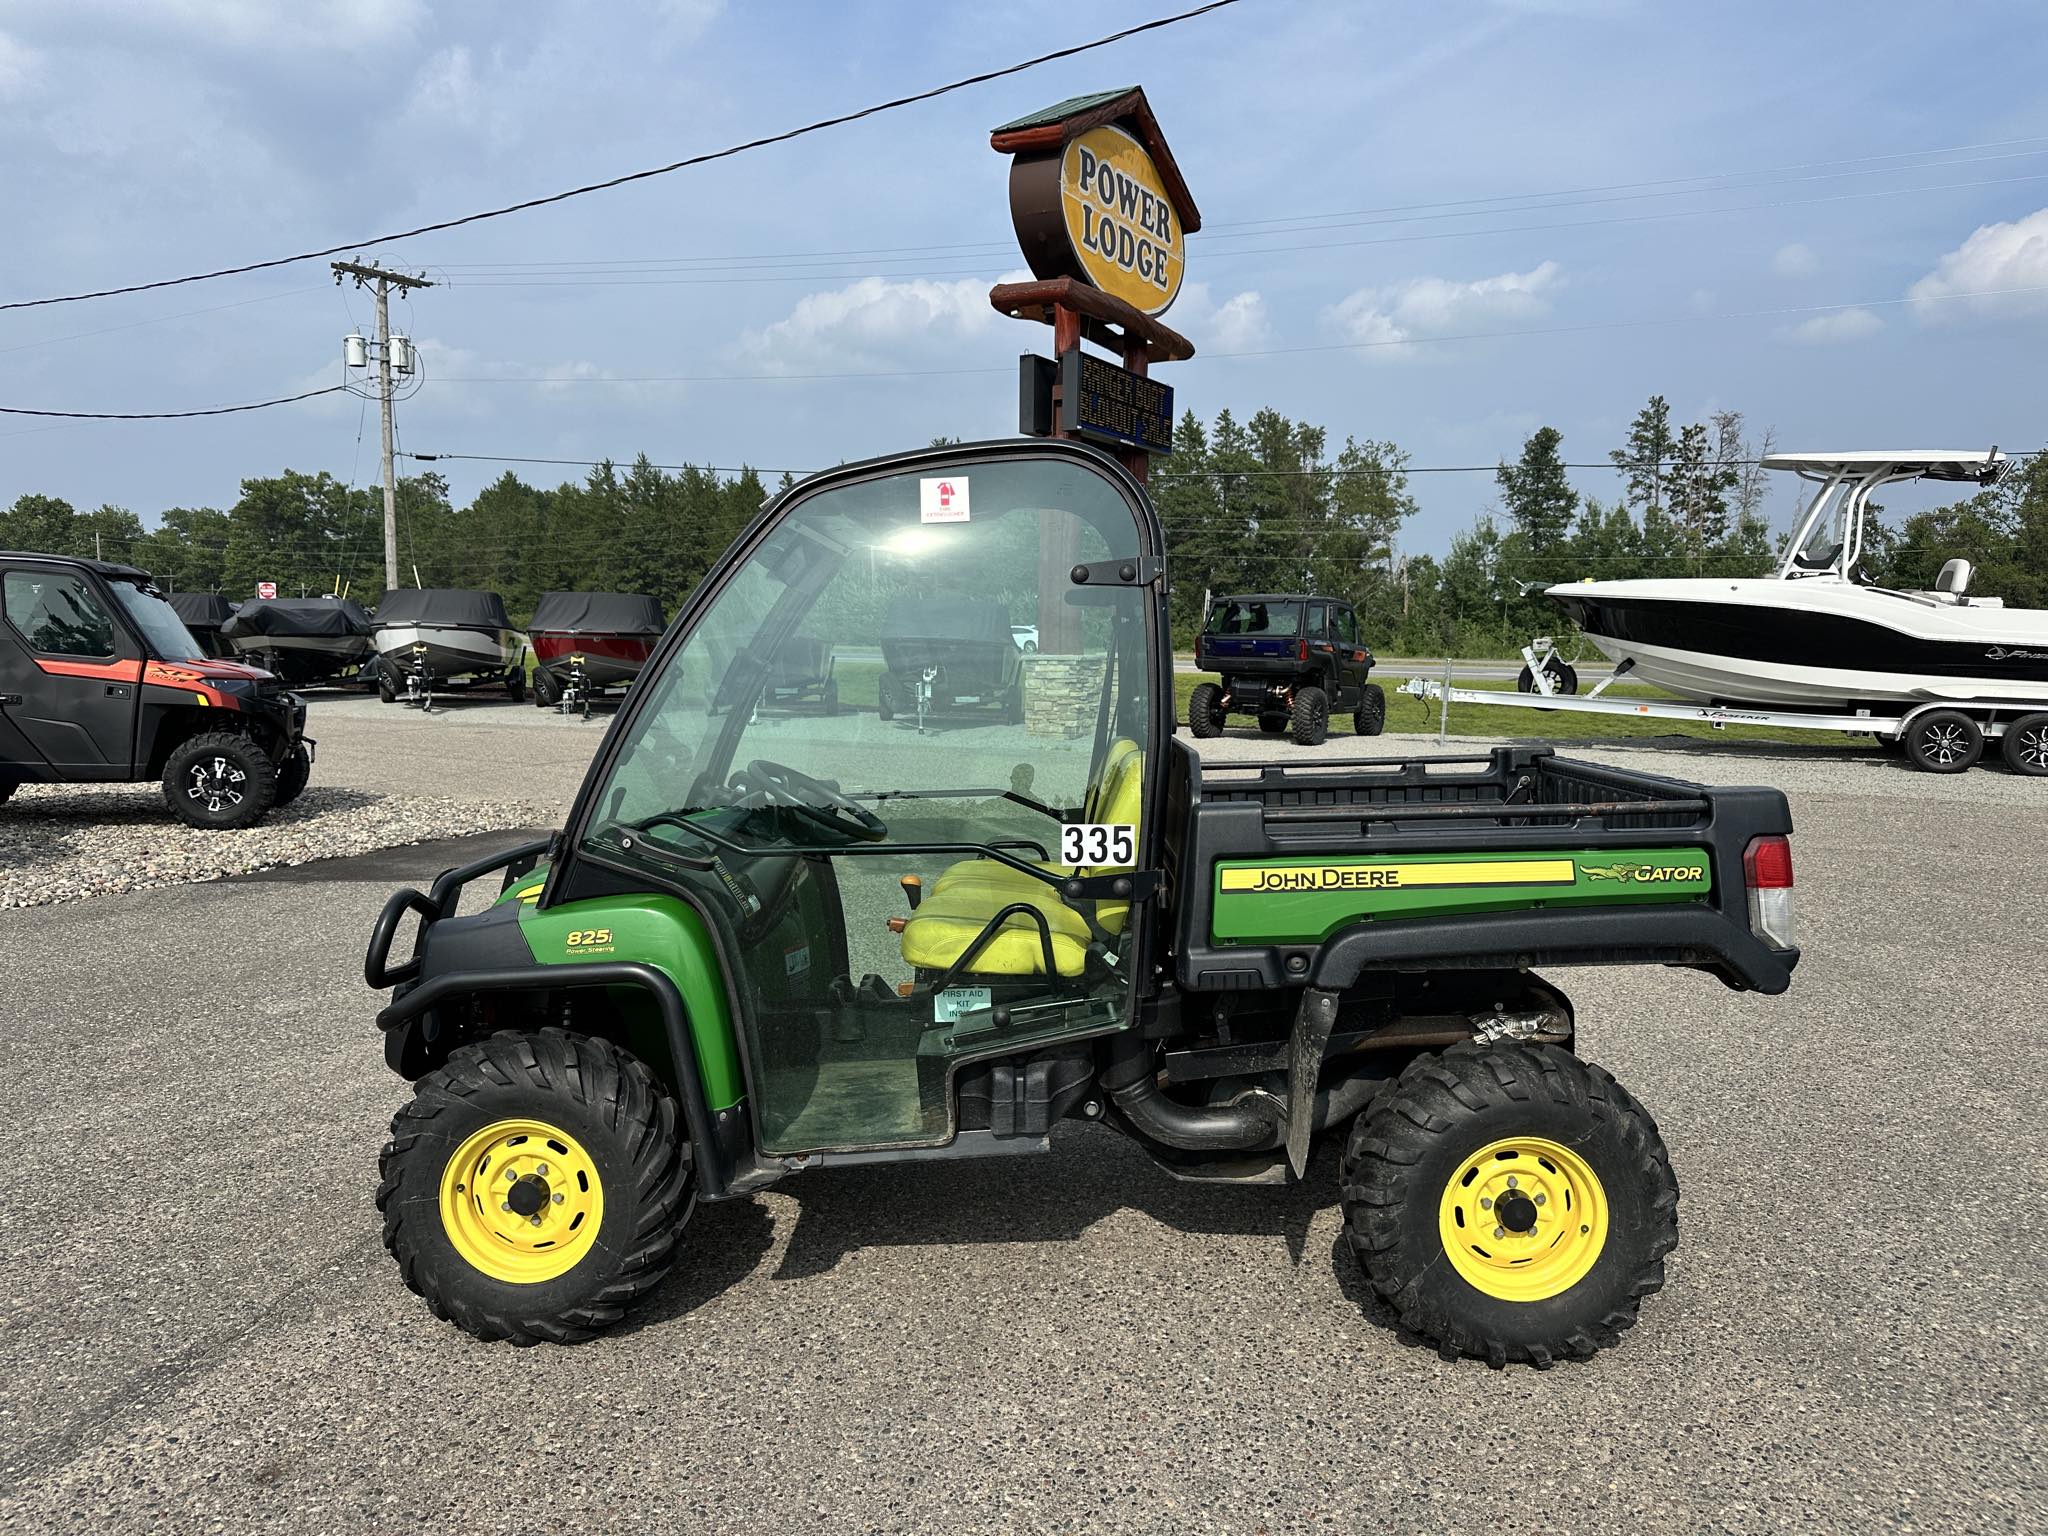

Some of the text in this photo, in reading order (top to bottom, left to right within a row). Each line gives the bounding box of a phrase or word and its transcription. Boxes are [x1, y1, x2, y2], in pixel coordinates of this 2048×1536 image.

[1078, 146, 1171, 246] POWER
[1082, 203, 1168, 289] LODGE
[1081, 358, 1166, 414] RANGER BOAT
[1080, 390, 1171, 447] BLOWOUT SALE
[1064, 826, 1133, 864] 335
[1253, 868, 1399, 889] JOHN DEERE
[1634, 865, 1703, 882] GATOR
[566, 929, 613, 946] 825i
[942, 990, 984, 998] FIRST AID
